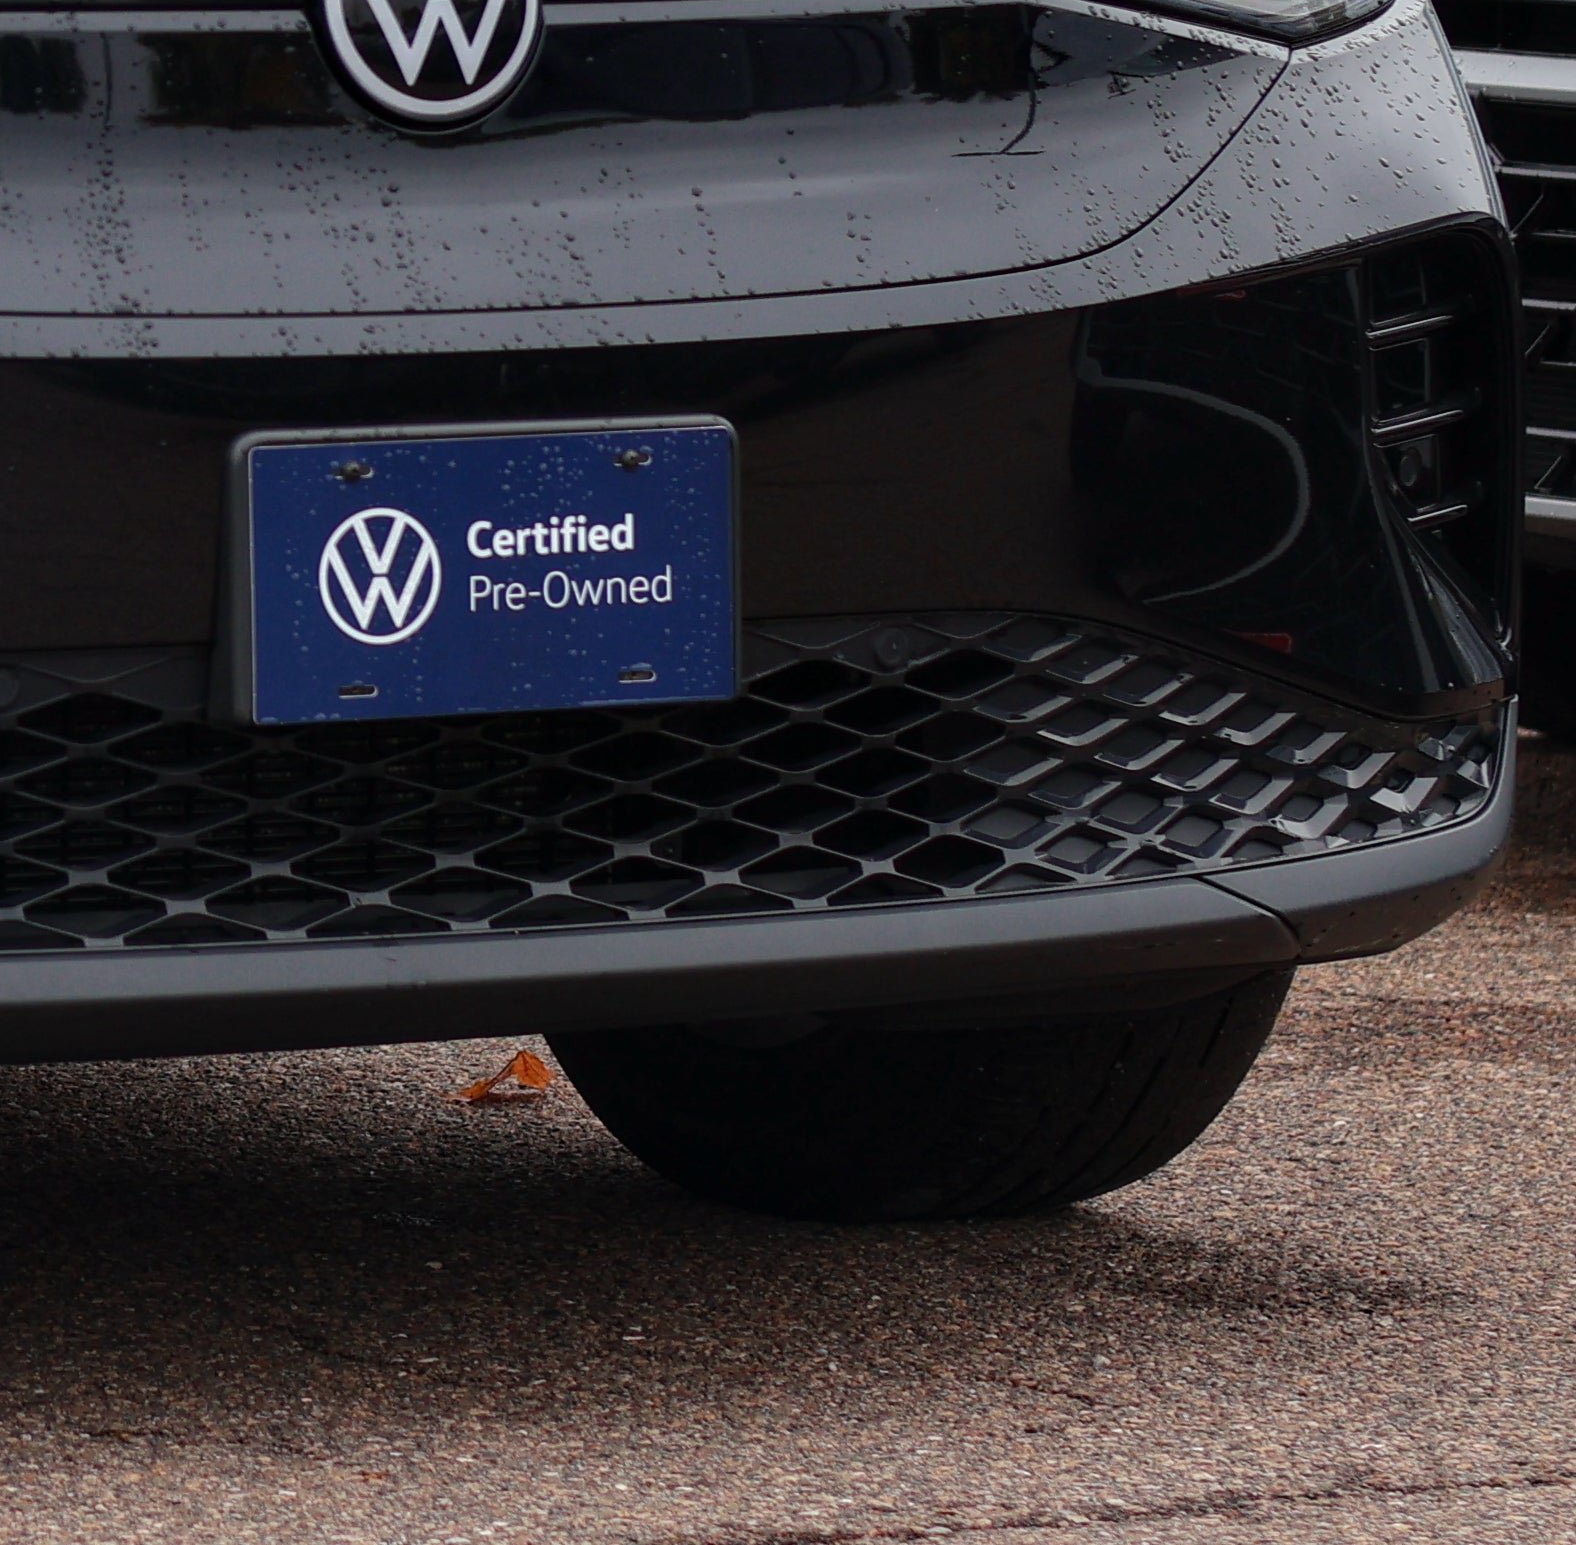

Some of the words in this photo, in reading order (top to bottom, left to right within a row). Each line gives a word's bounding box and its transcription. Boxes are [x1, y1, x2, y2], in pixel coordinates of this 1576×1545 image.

[466, 512, 636, 558] Certified
[319, 507, 442, 645] VW
[468, 564, 674, 613] Pre-Owned
